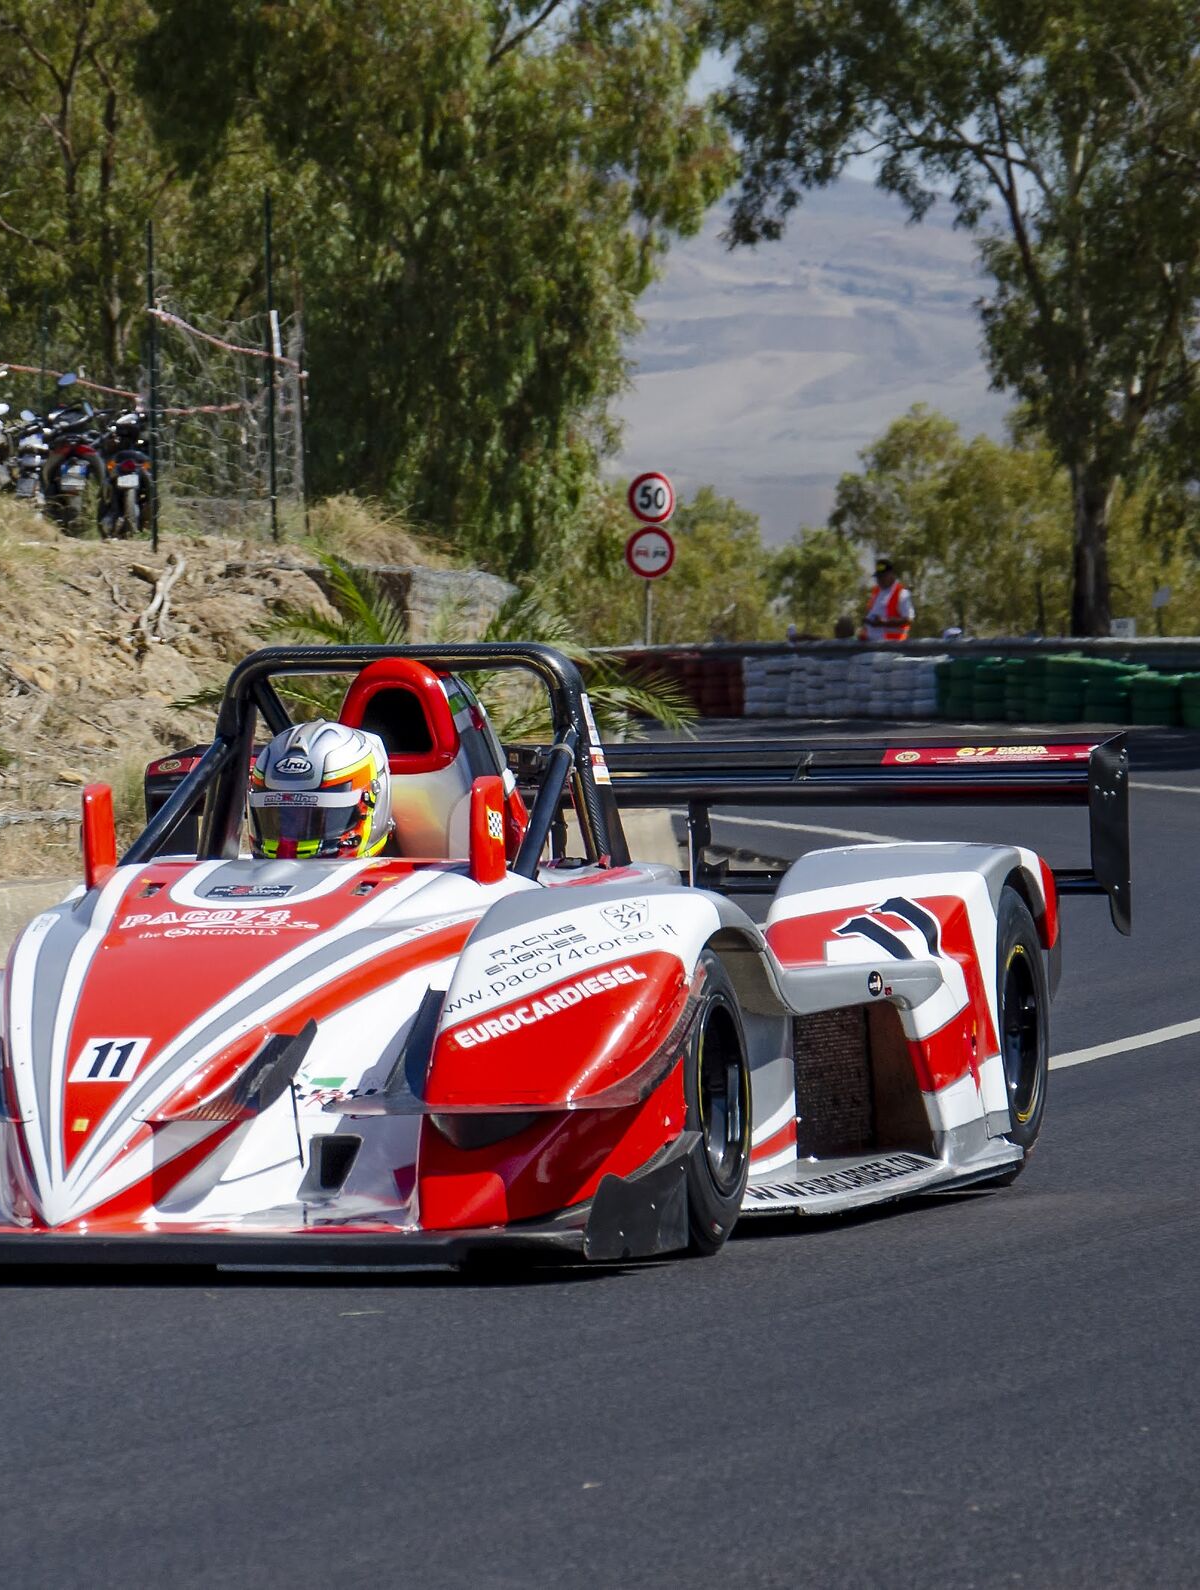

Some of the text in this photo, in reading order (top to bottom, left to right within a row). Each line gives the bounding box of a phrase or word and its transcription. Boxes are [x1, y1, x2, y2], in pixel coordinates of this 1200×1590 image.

[639, 485, 665, 510] 50
[277, 758, 308, 769] Arai
[119, 910, 291, 929] PACO74
[139, 931, 162, 939] the
[831, 896, 943, 962] 11
[484, 933, 588, 976] ENGINES
[489, 924, 577, 959] RACING
[453, 965, 648, 1049] EUROCARDIESEL
[87, 1041, 138, 1078] 11
